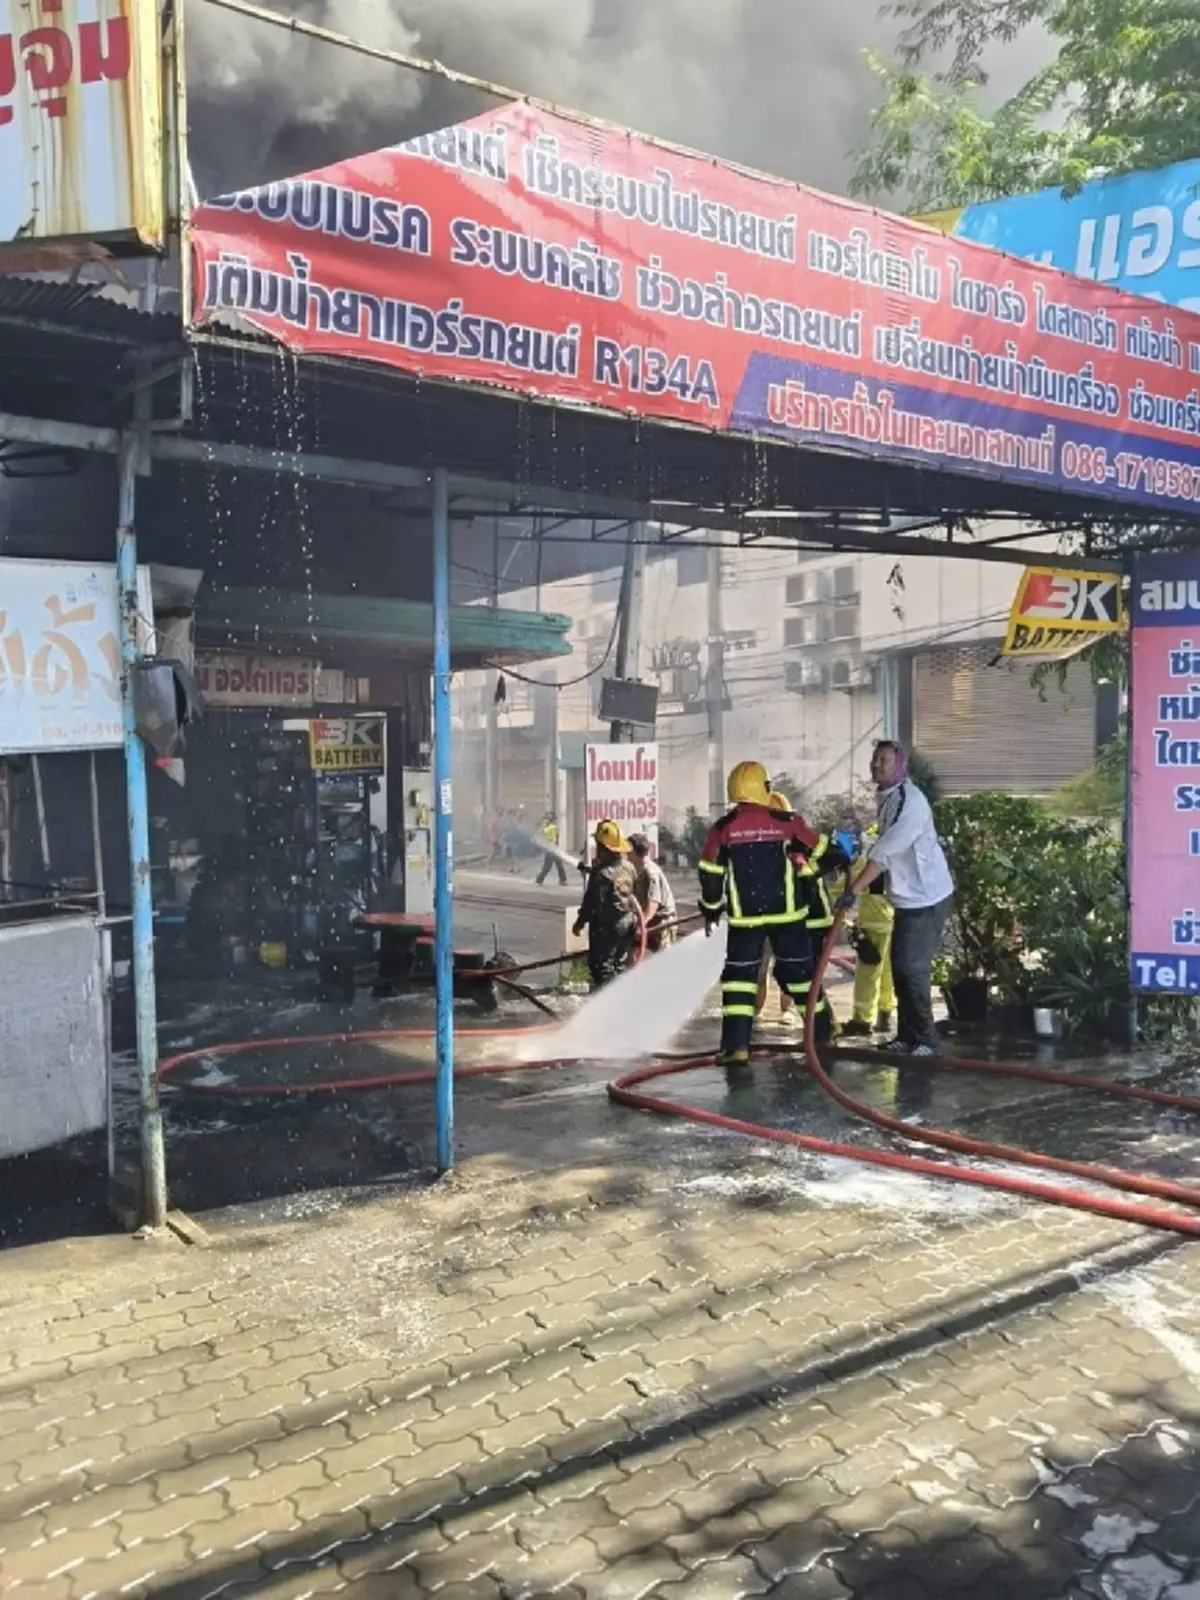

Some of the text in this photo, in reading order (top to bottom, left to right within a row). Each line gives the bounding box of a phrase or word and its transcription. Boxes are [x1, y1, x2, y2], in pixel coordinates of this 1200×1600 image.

[947, 255, 1029, 328] ไดชาร์จ
[1124, 315, 1184, 370] หม้อน้ำ
[593, 334, 721, 408] R134A
[766, 379, 1056, 475] บริการทั้งในและนอกสถานที่
[314, 747, 382, 767] BATTERY
[587, 745, 657, 782] ไดนาโม
[1135, 958, 1199, 990] Tel.
